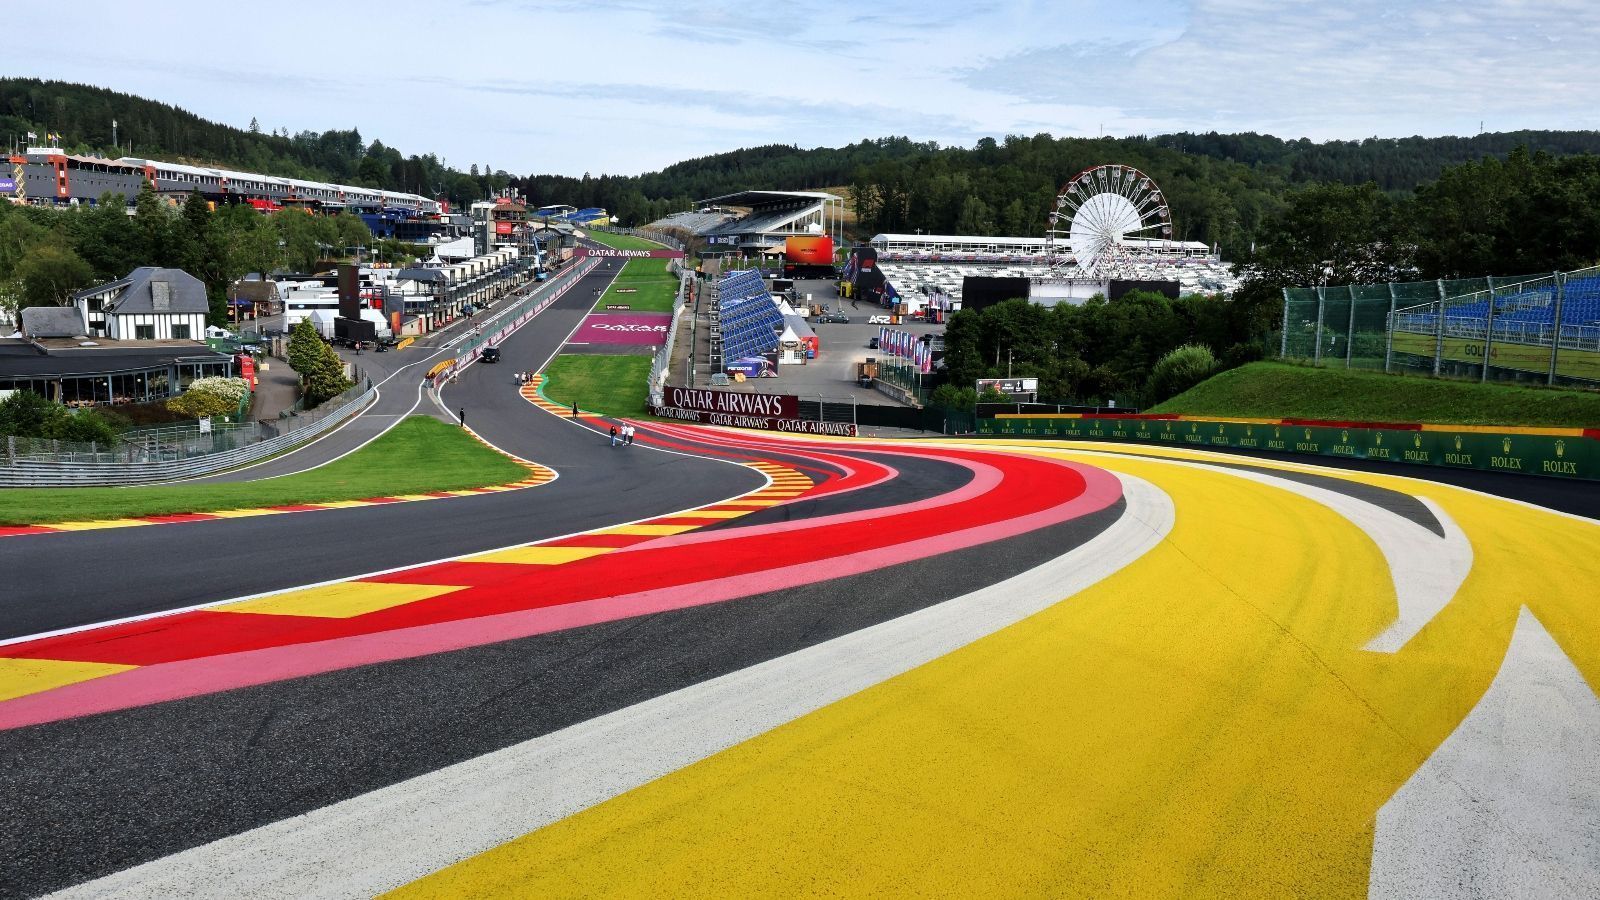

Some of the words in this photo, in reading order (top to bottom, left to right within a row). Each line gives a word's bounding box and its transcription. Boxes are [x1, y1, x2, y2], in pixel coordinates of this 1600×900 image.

[673, 389, 714, 410] QATAR
[717, 391, 782, 415] AIRWAYS
[654, 406, 674, 418] QATAR
[674, 409, 700, 422] AIRWAYS
[710, 414, 732, 426] QATAR
[734, 416, 769, 429] AIRWAYS
[777, 419, 807, 432] QATAR
[809, 422, 850, 436] AIRWAYS
[1296, 443, 1318, 452] ROLEX
[1333, 445, 1354, 455] ROLEX
[1368, 448, 1389, 458] ROLEX
[1405, 451, 1429, 461] ROLEX
[1446, 453, 1472, 465] ROLEX
[1491, 456, 1522, 469] ROLEX
[1543, 460, 1577, 474] ROLEX
